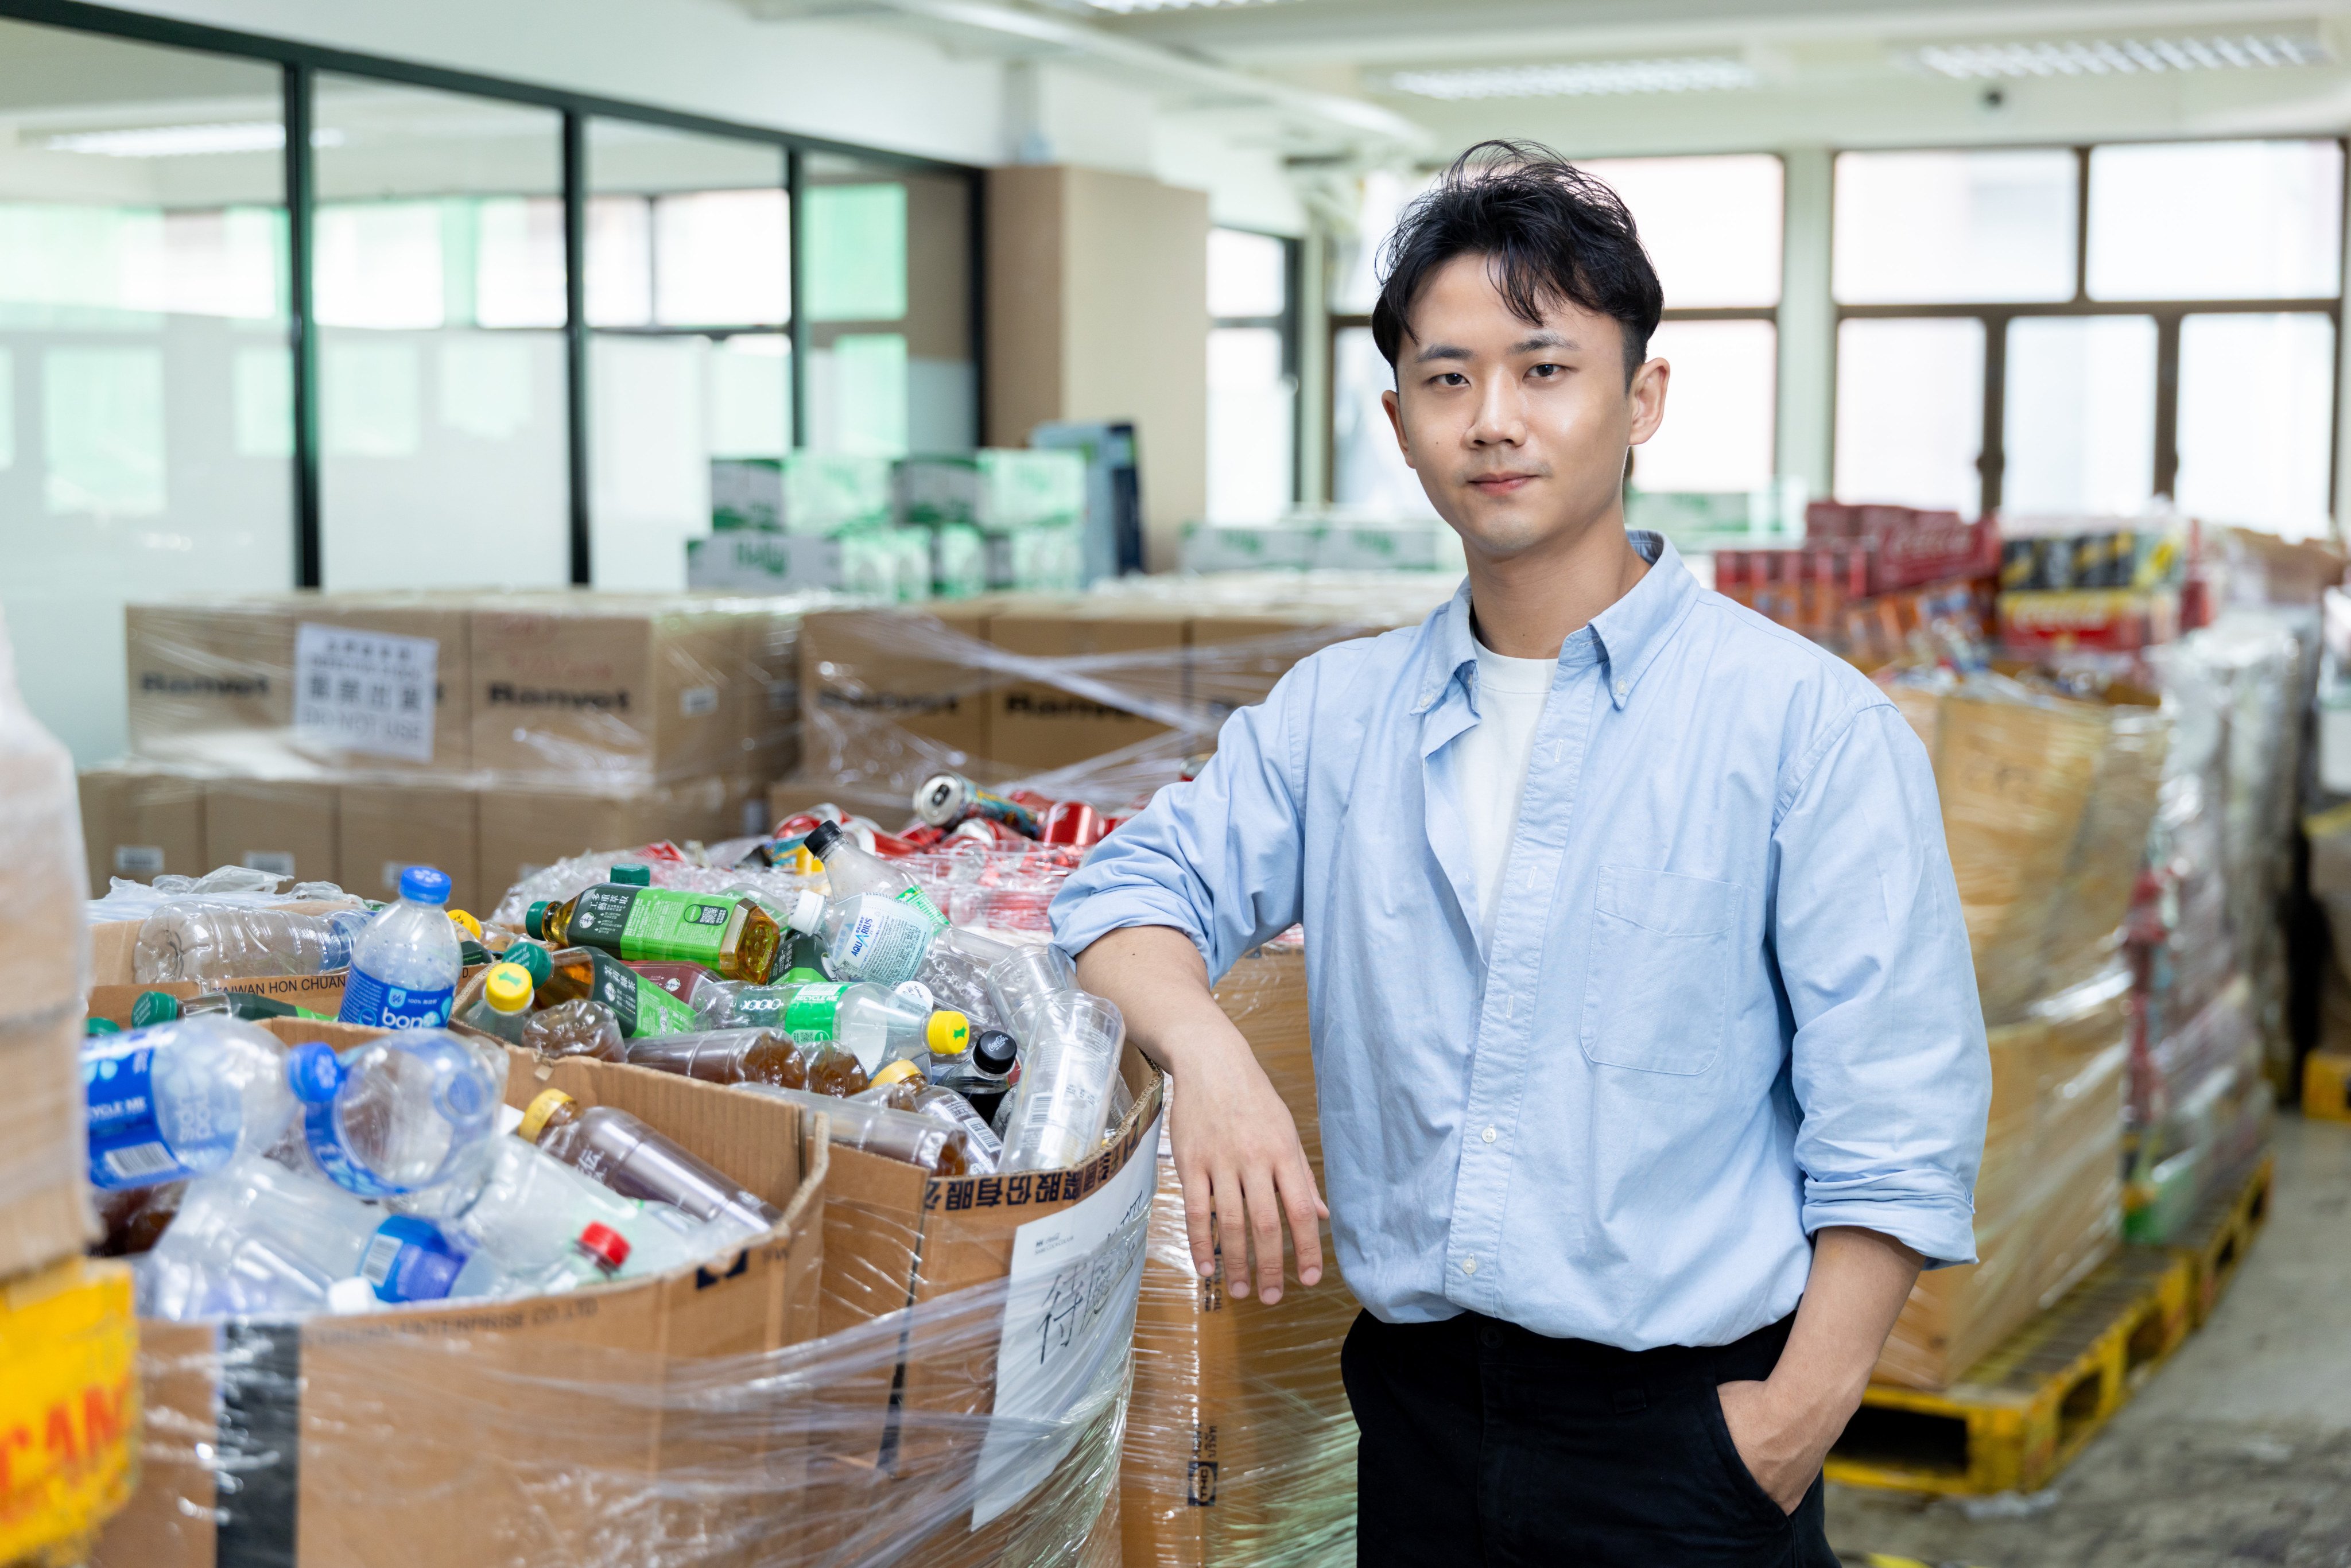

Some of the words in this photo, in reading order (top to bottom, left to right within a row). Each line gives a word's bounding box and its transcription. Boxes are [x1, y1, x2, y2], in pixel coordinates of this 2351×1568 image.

[851, 918, 873, 957] AQUARIUS
[269, 980, 297, 993] HON
[301, 976, 346, 991] CHUAN
[988, 1034, 1007, 1051] Coca-Cola
[1200, 1469, 1209, 1499] THC
